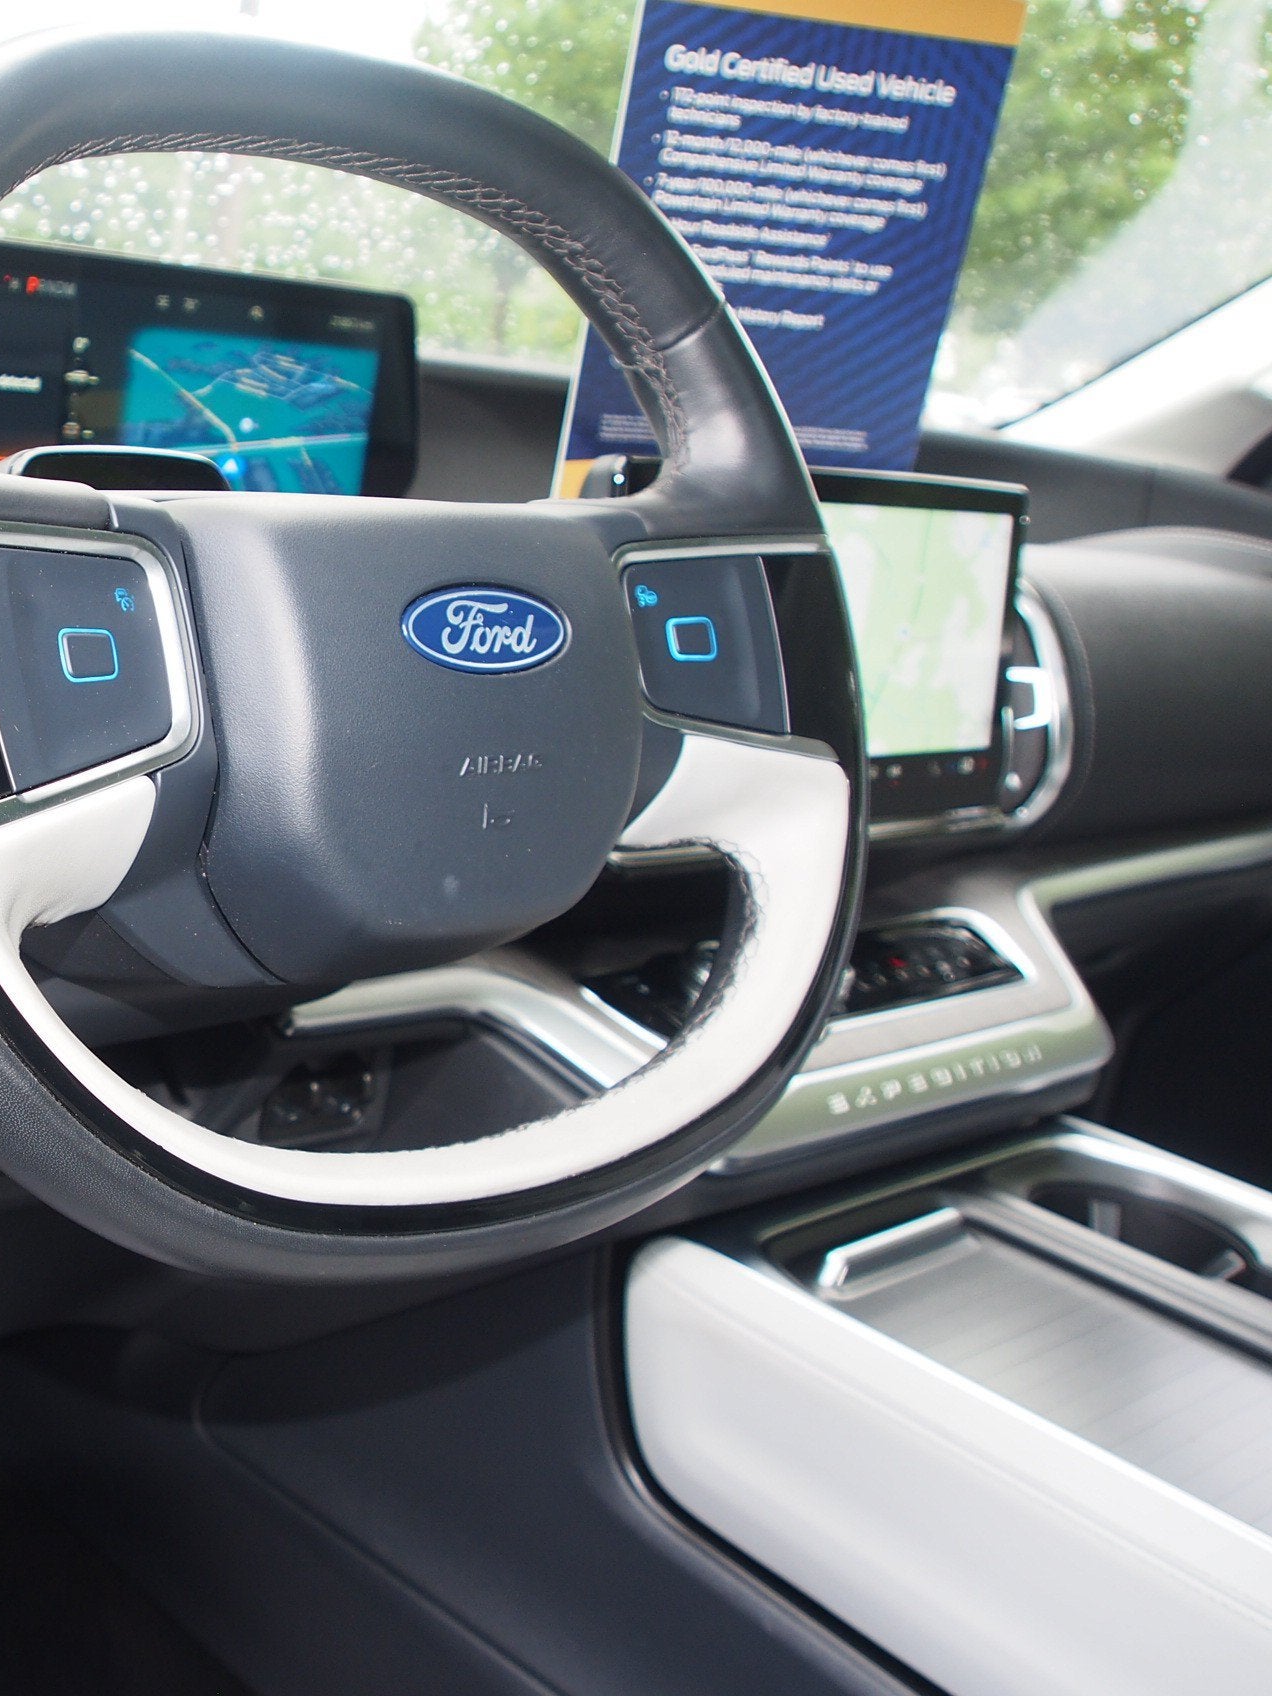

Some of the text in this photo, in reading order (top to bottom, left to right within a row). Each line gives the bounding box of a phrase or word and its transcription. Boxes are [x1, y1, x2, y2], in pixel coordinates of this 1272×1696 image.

[664, 44, 957, 107] Gold Certified Used Vehicle
[759, 159, 807, 182] Limited
[807, 165, 863, 190] Warranty
[863, 173, 924, 197] coverage
[701, 220, 759, 243] Roadside
[723, 198, 770, 220] Limited
[770, 203, 828, 228] Warranty
[828, 211, 887, 235] coverage
[441, 600, 537, 654] Ford
[827, 1044, 1043, 1115] EXPEDITION
